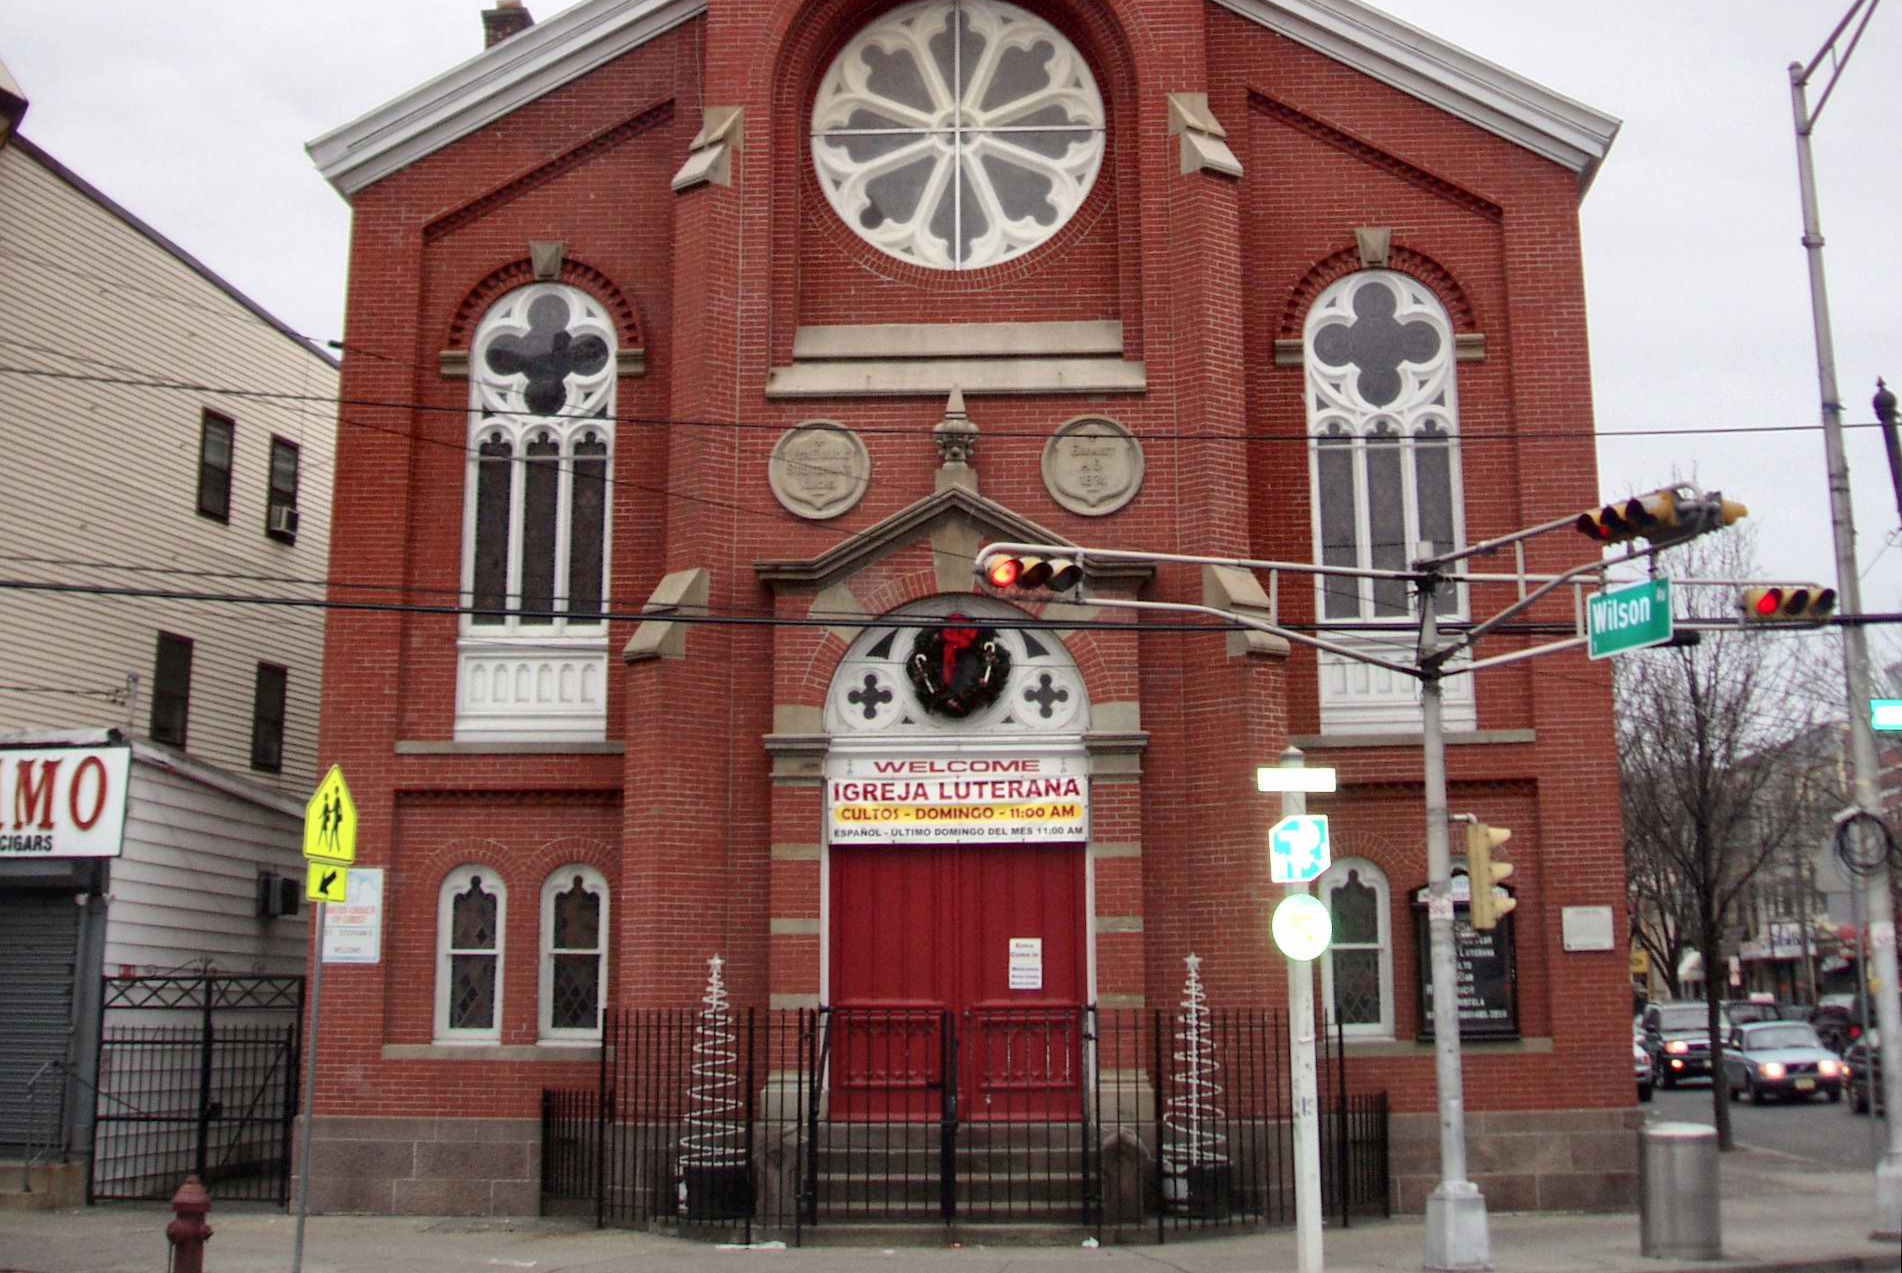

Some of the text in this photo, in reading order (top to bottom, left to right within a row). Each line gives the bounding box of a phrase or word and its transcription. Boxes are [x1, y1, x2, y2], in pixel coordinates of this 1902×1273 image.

[1592, 596, 1650, 634] Wilson
[874, 760, 1040, 773] WELCOME
[0, 755, 107, 831] MO
[833, 778, 1081, 801] IGREJA LUTERANA
[841, 808, 899, 820] CULTOS
[915, 807, 994, 820] DOMINGO
[1010, 808, 1045, 818] 11:00
[1051, 805, 1075, 817] AM
[935, 828, 984, 836] DOMINGO
[988, 827, 1008, 835] DEL
[1037, 827, 1064, 835] 11:00
[1067, 826, 1083, 835] AM
